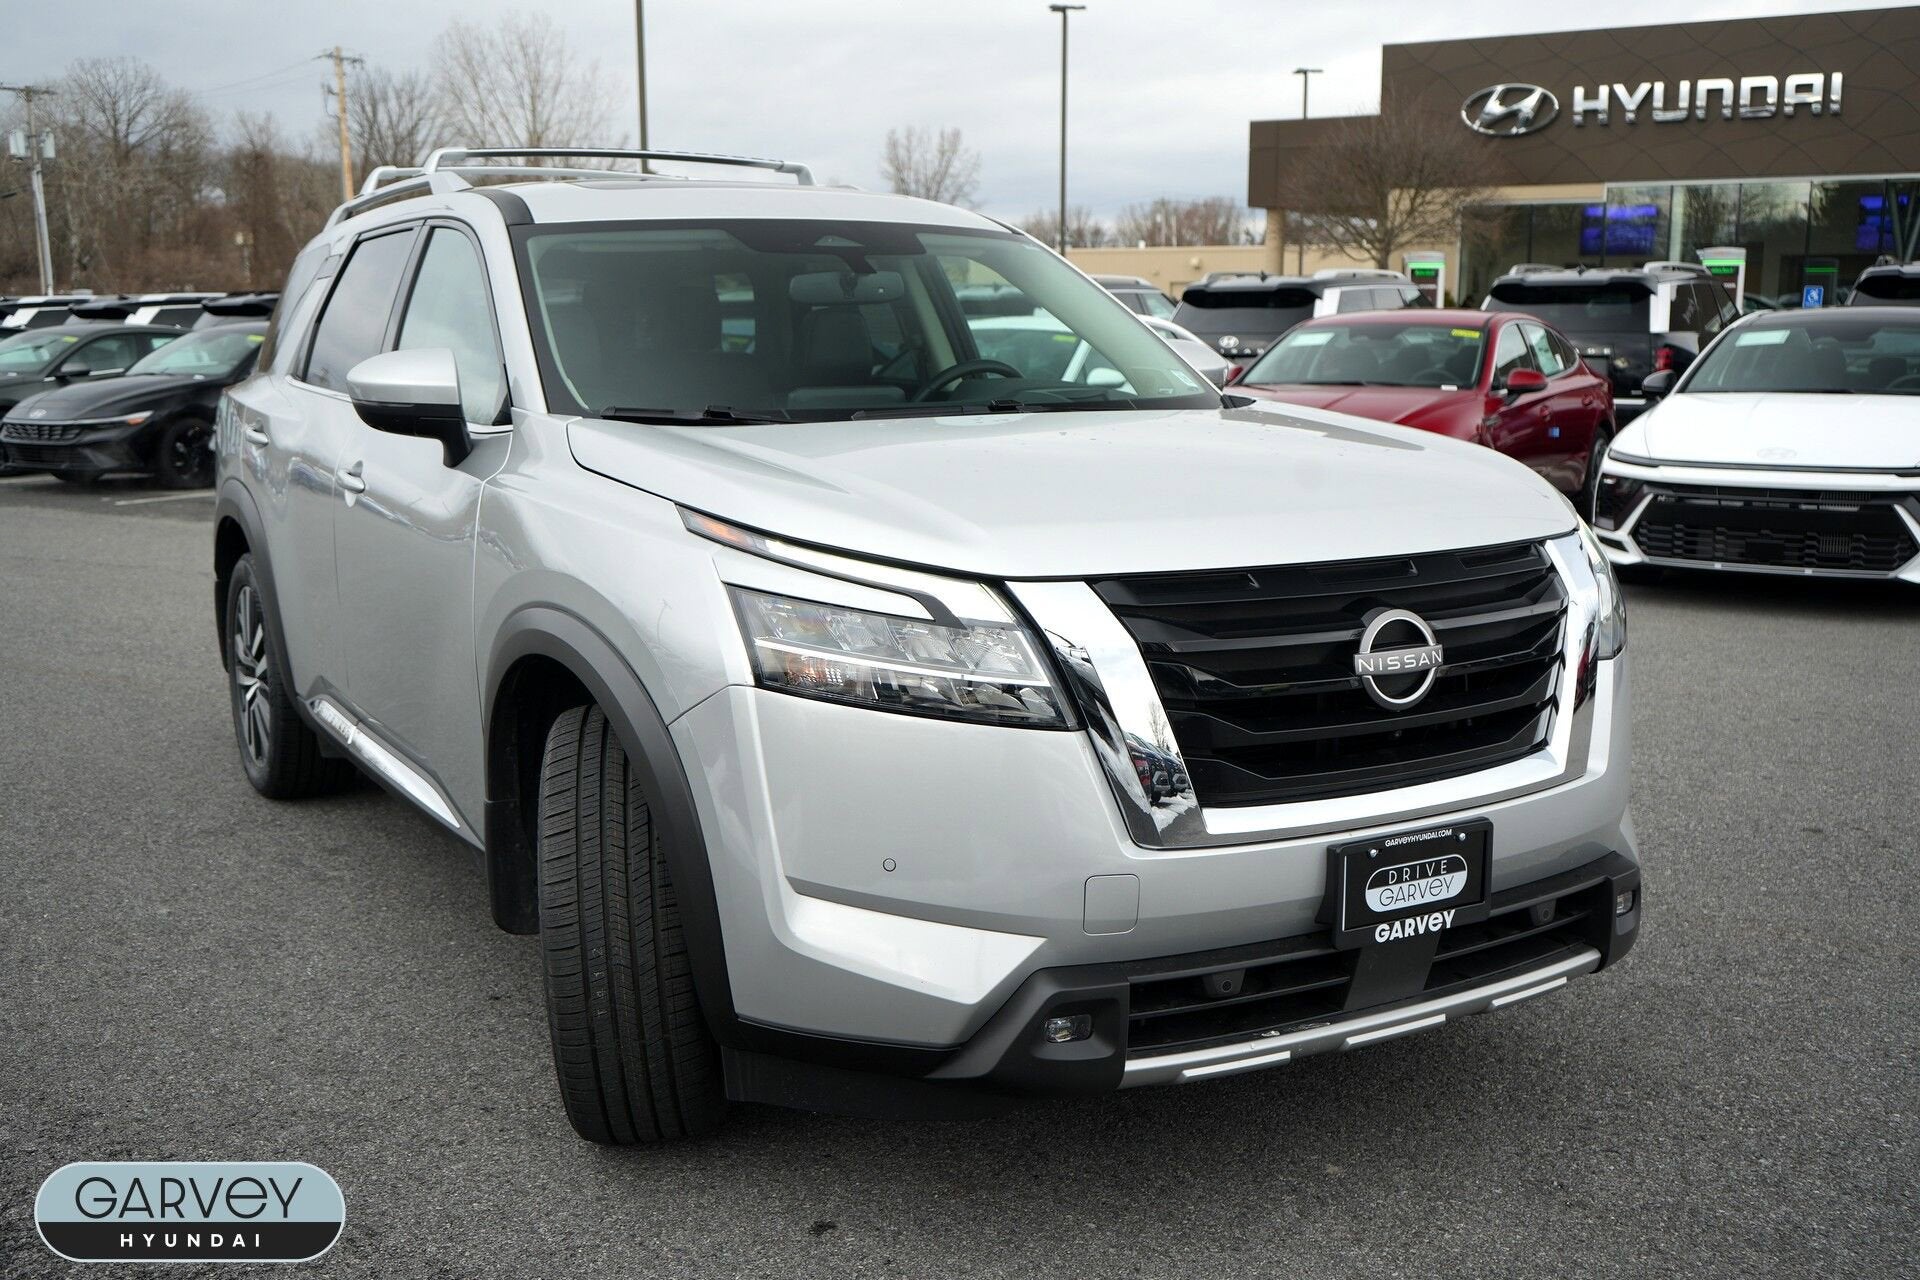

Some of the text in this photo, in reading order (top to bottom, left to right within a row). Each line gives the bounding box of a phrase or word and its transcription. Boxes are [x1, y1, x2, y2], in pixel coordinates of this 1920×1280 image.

[1572, 72, 1843, 127] HYUNDAI
[1358, 649, 1442, 672] NISSAN
[1388, 860, 1449, 884] DRIVE
